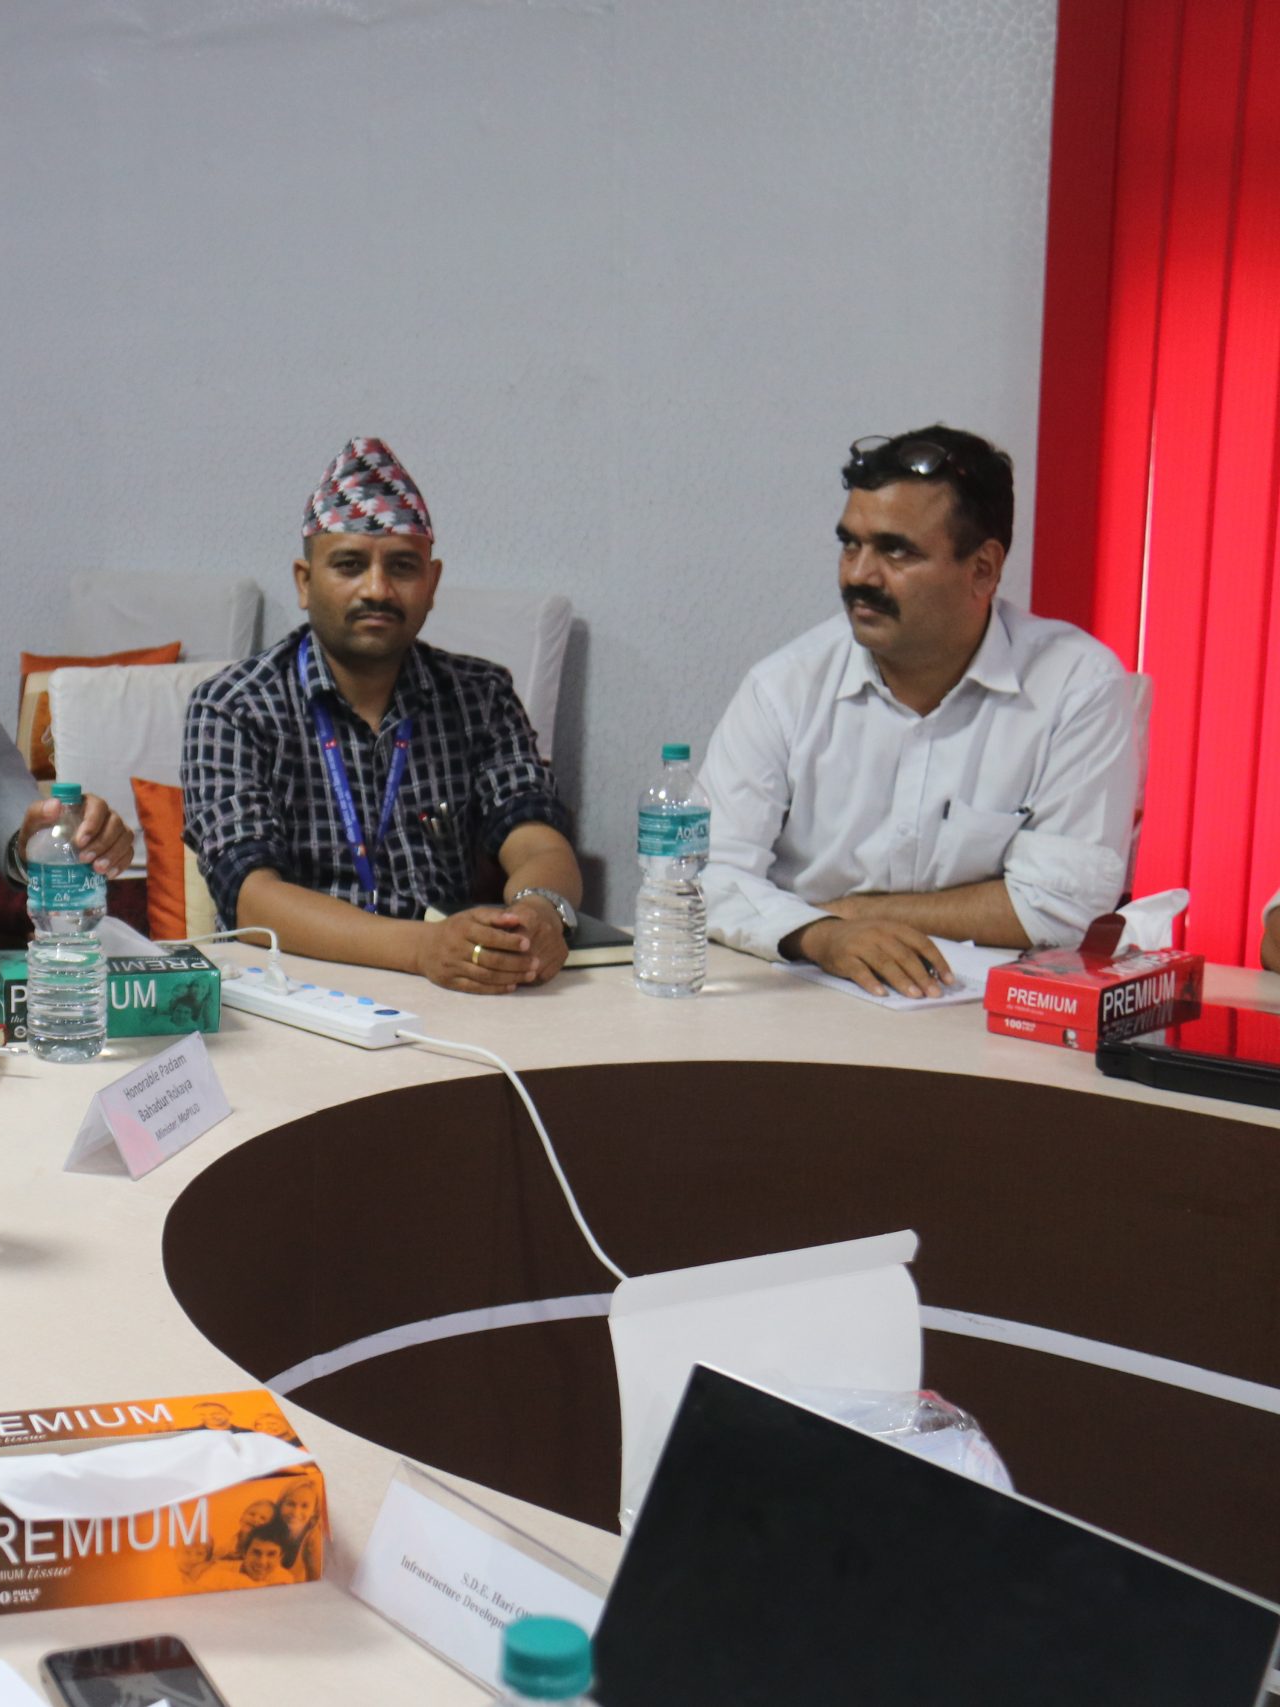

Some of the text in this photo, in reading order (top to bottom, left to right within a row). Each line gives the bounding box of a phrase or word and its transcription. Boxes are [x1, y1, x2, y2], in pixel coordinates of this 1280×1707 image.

[108, 960, 210, 972] PREMI
[1007, 986, 1078, 1015] PREMIUM
[1102, 970, 1176, 1022] PREMIUM
[1004, 1018, 1022, 1029] 100
[123, 1054, 188, 1101] Honorable Padam
[137, 1079, 193, 1122] Bahadur Rokaya
[27, 1565, 73, 1580] tissue
[400, 1554, 462, 1602] Infrastructure
[461, 1572, 489, 1599] S.D.E.
[491, 1592, 514, 1615] Hari
